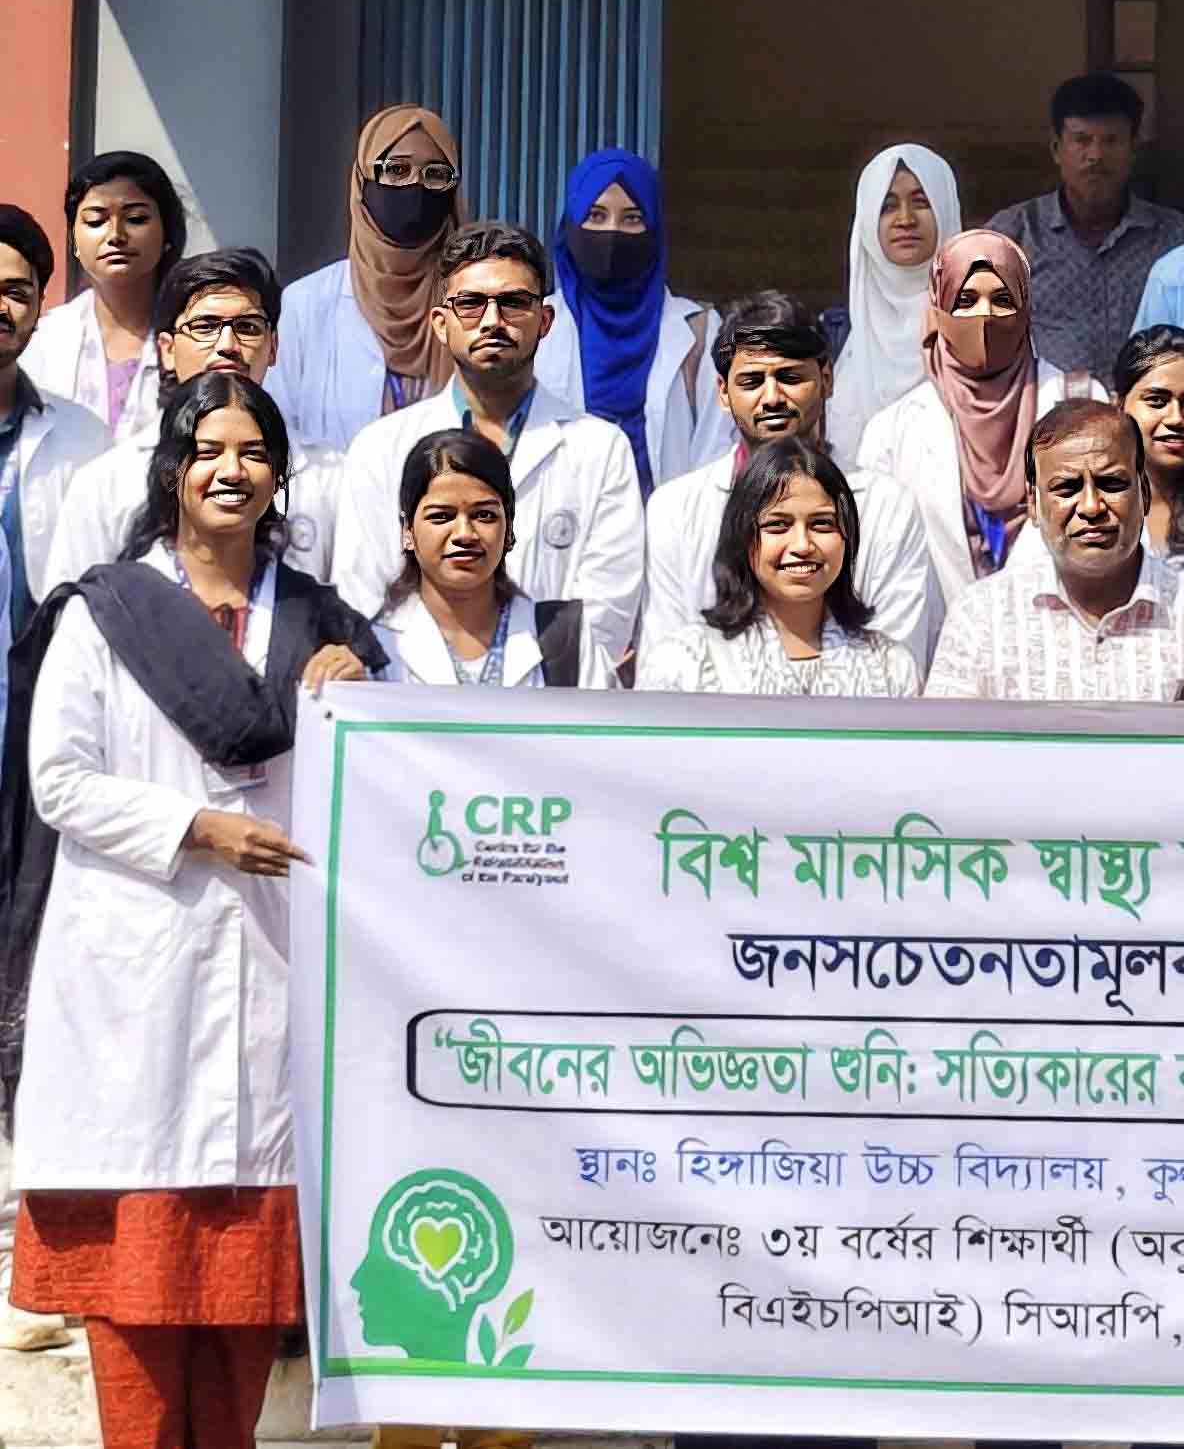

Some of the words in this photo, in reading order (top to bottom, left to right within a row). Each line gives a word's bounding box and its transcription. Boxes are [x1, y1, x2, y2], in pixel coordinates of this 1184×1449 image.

[465, 795, 573, 836] CRP
[655, 808, 768, 901] বিশ্ব
[784, 812, 1015, 903] মানসিক
[1028, 834, 1161, 921] স্বাস্থ্য
[629, 1024, 814, 1101] অভিজ্ঞতা
[933, 1029, 1161, 1106] সত্যিকারের
[674, 1137, 848, 1187] হিঙ্গাজিয়া
[862, 1140, 942, 1186] উচ্চ
[760, 1225, 824, 1258] ৩য়
[837, 1212, 941, 1261] বর্ষের
